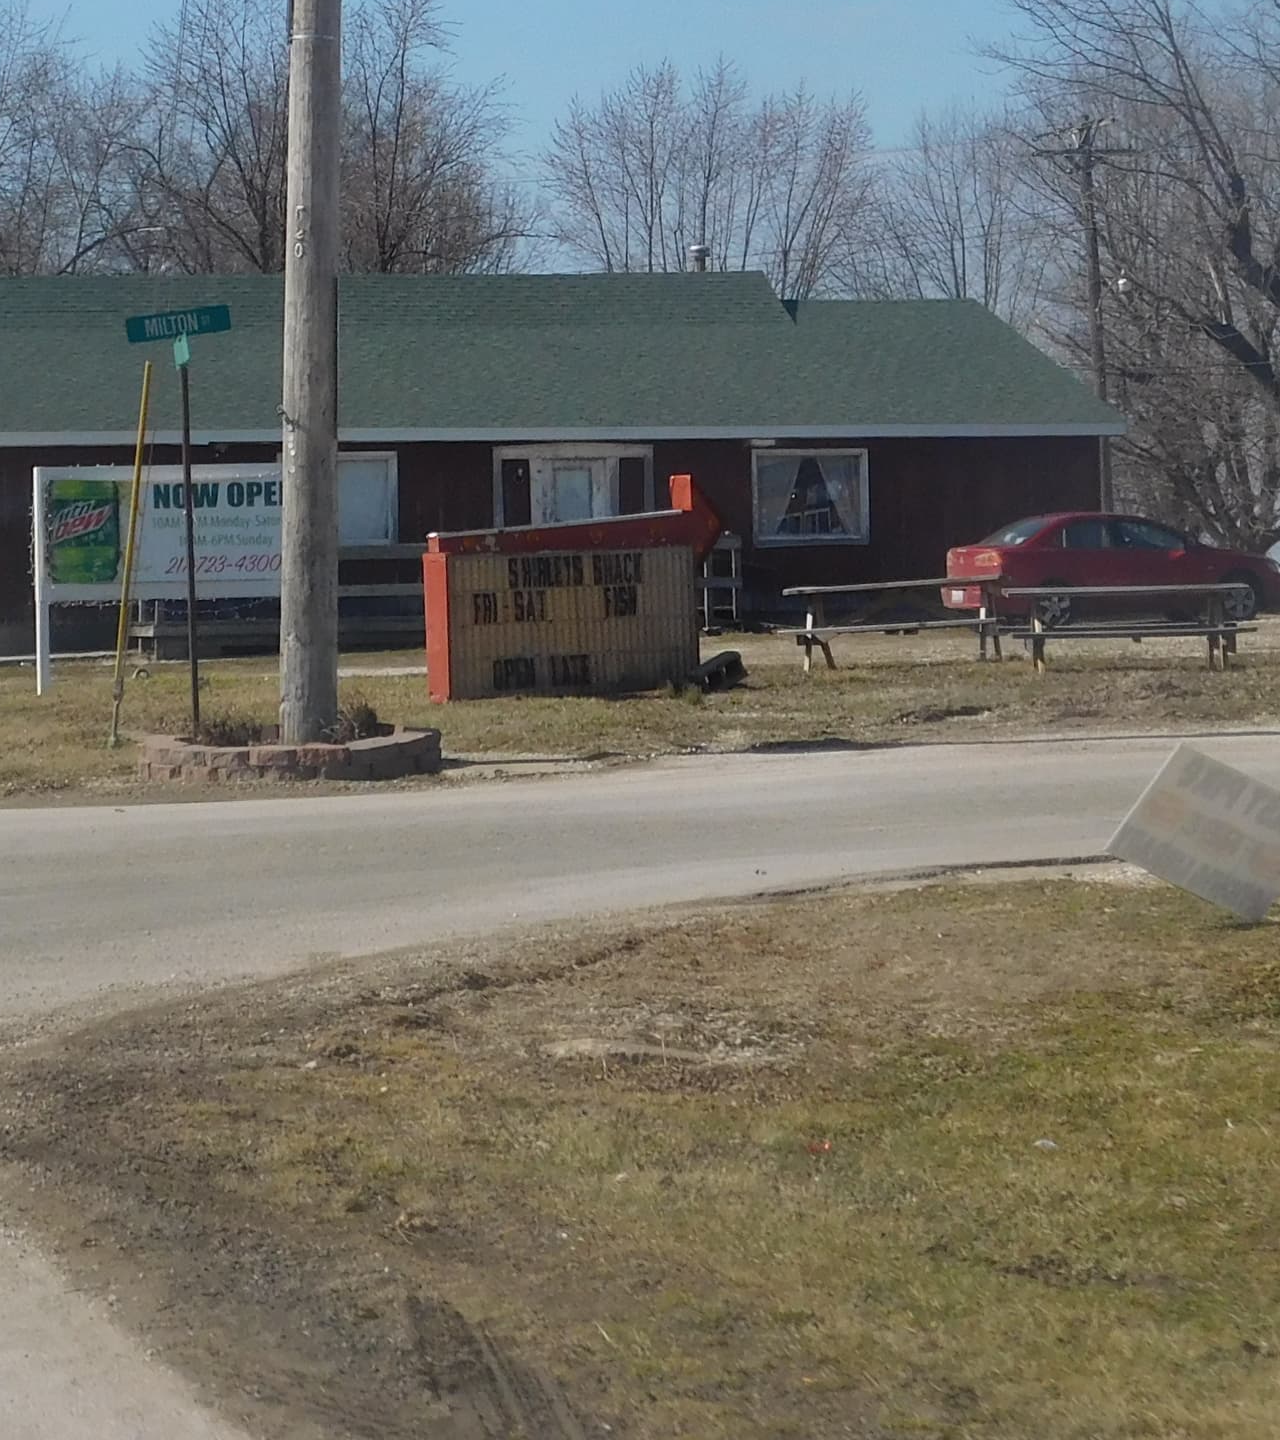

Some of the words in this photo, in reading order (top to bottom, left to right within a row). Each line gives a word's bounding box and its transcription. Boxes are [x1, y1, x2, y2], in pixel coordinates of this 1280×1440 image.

[144, 312, 199, 337] MILTON
[153, 482, 219, 509] NOW
[164, 554, 282, 574] 21723-4300
[473, 593, 497, 624] FRI
[514, 590, 544, 622] SAT
